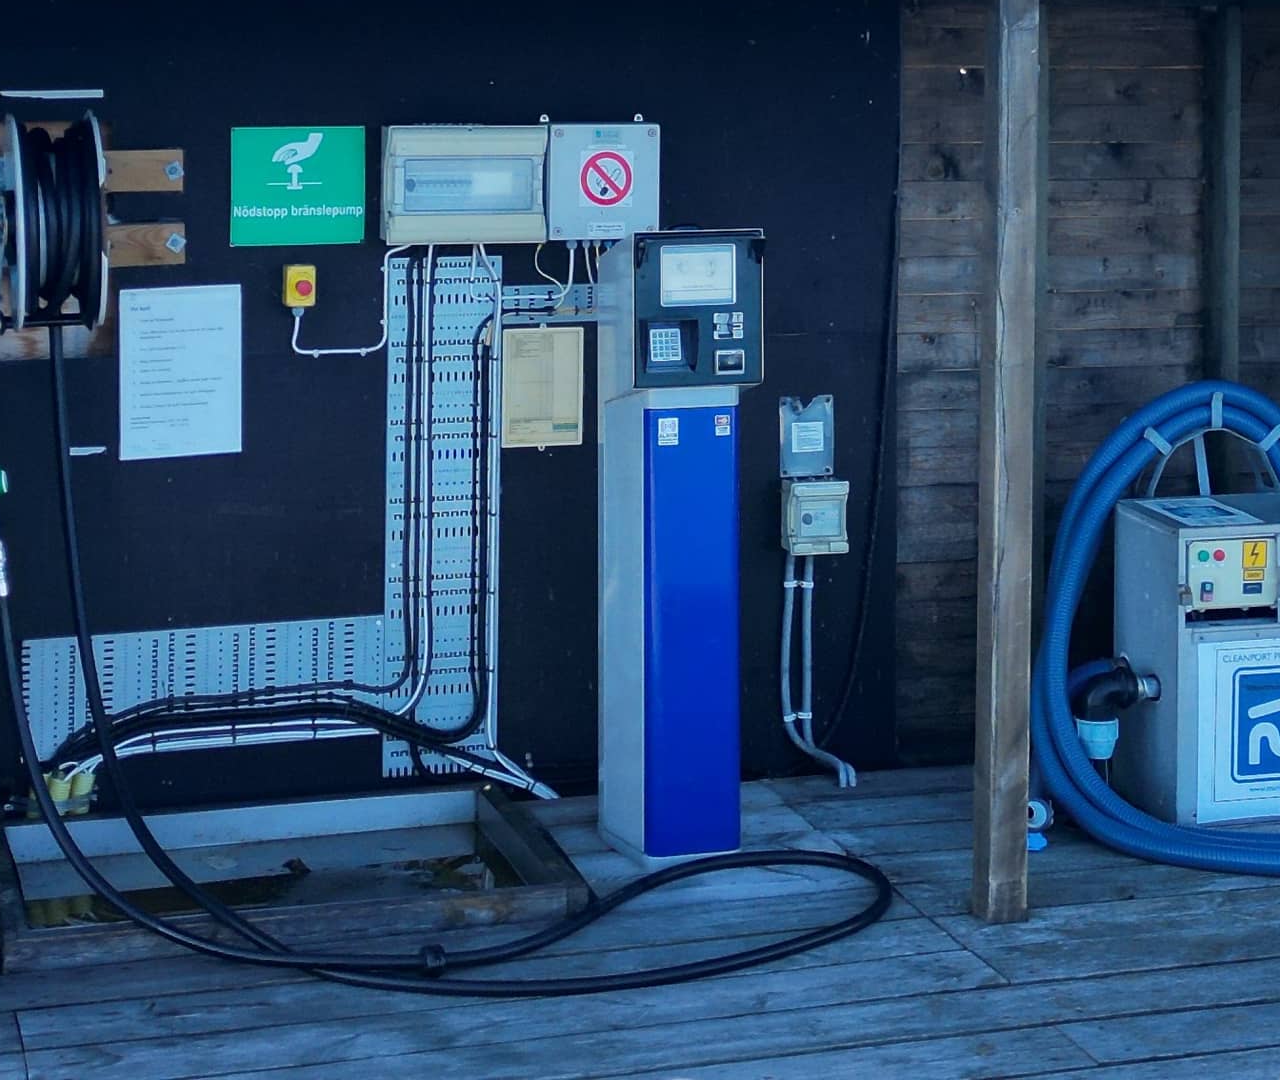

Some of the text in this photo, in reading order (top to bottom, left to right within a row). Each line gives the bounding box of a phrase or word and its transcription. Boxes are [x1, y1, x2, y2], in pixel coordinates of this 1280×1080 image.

[233, 204, 363, 219] Nödstopp bränslepump
[1222, 652, 1272, 663] CLEANPORT
